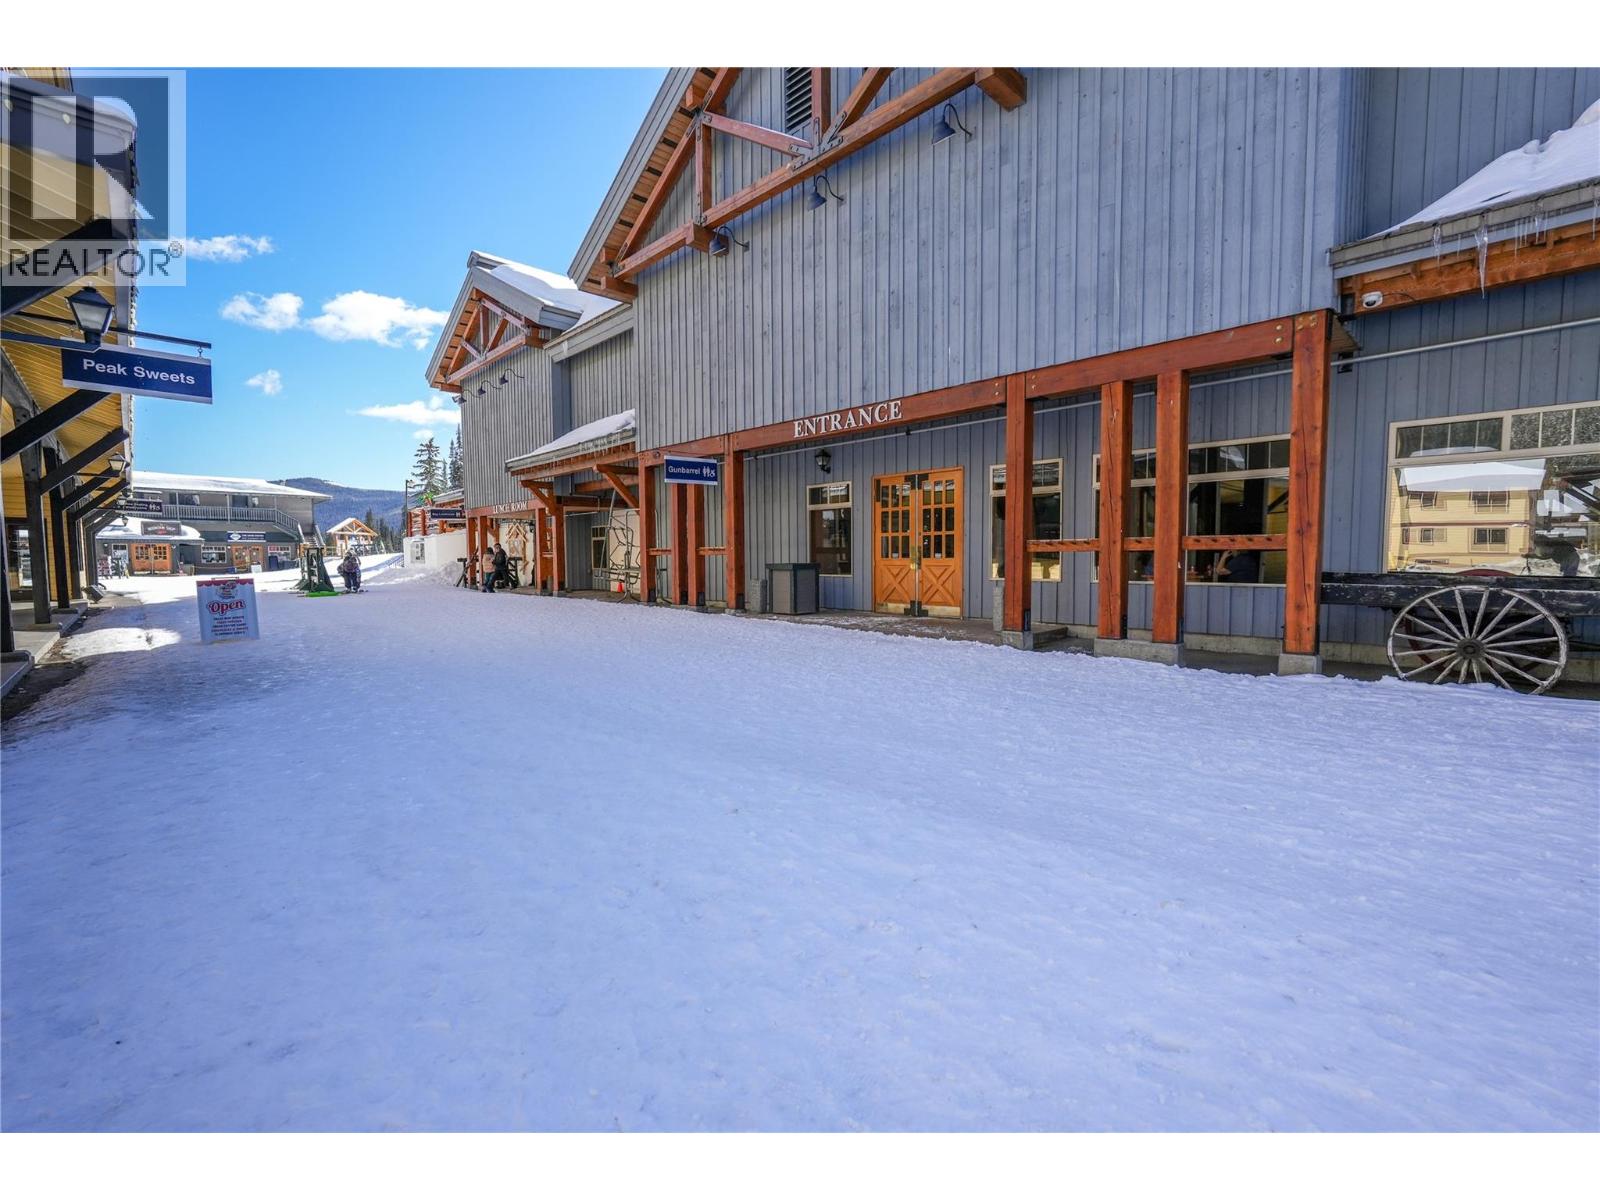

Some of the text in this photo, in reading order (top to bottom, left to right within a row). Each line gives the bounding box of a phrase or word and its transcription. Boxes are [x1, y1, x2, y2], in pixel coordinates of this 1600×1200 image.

[83, 358, 196, 385] Peak Sweets
[793, 400, 902, 438] ENTRANCE
[668, 465, 701, 475] Gunbarrel
[511, 501, 527, 512] ROOM
[208, 600, 244, 615] Open
